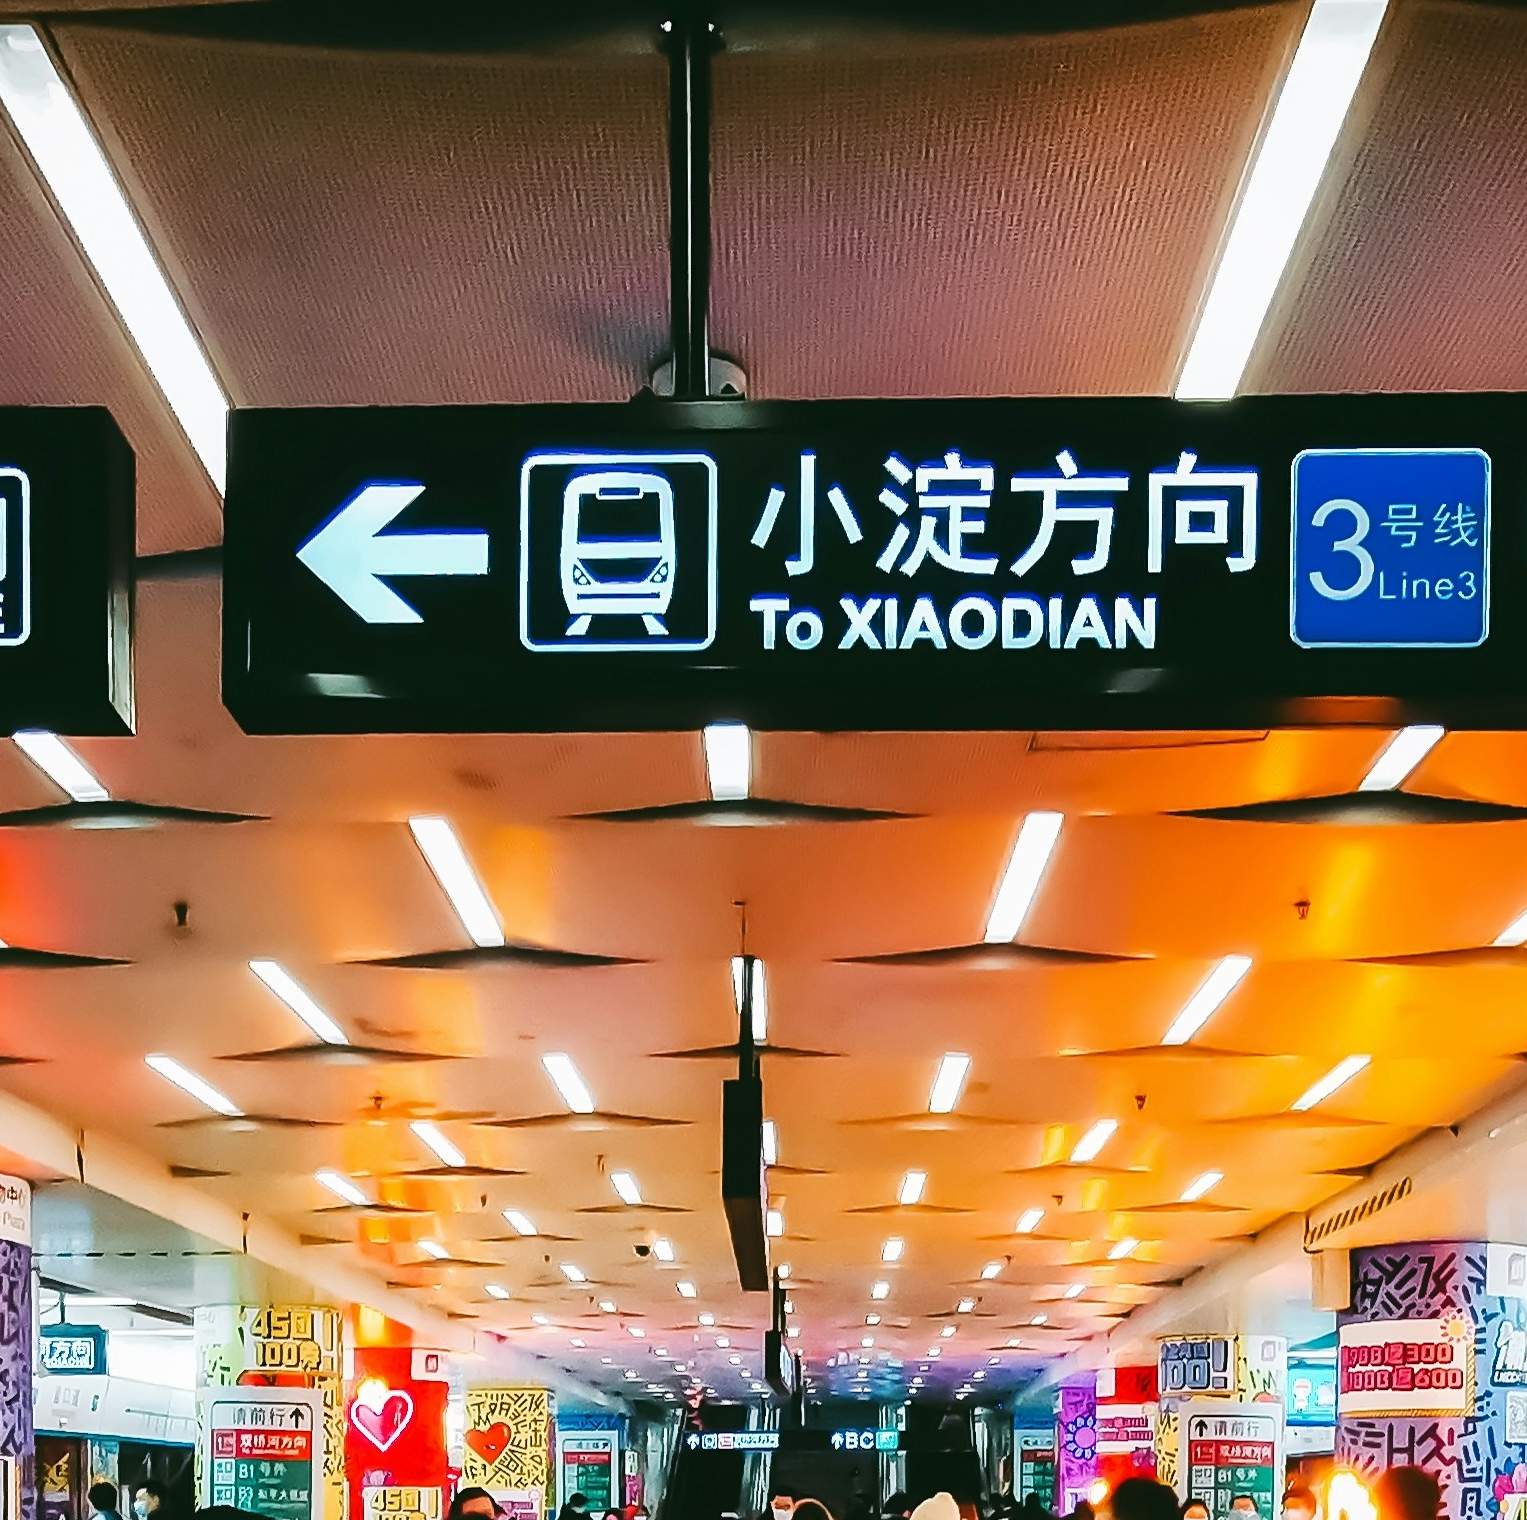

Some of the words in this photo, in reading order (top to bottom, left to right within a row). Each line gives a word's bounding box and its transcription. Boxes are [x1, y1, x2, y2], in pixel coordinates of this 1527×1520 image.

[750, 450, 1258, 578] 小淀方向
[1379, 503, 1479, 549] 号线
[1308, 499, 1376, 601] 3
[1377, 571, 1478, 601] Line3
[748, 597, 822, 650] To
[838, 597, 1157, 650] XIAODIAN
